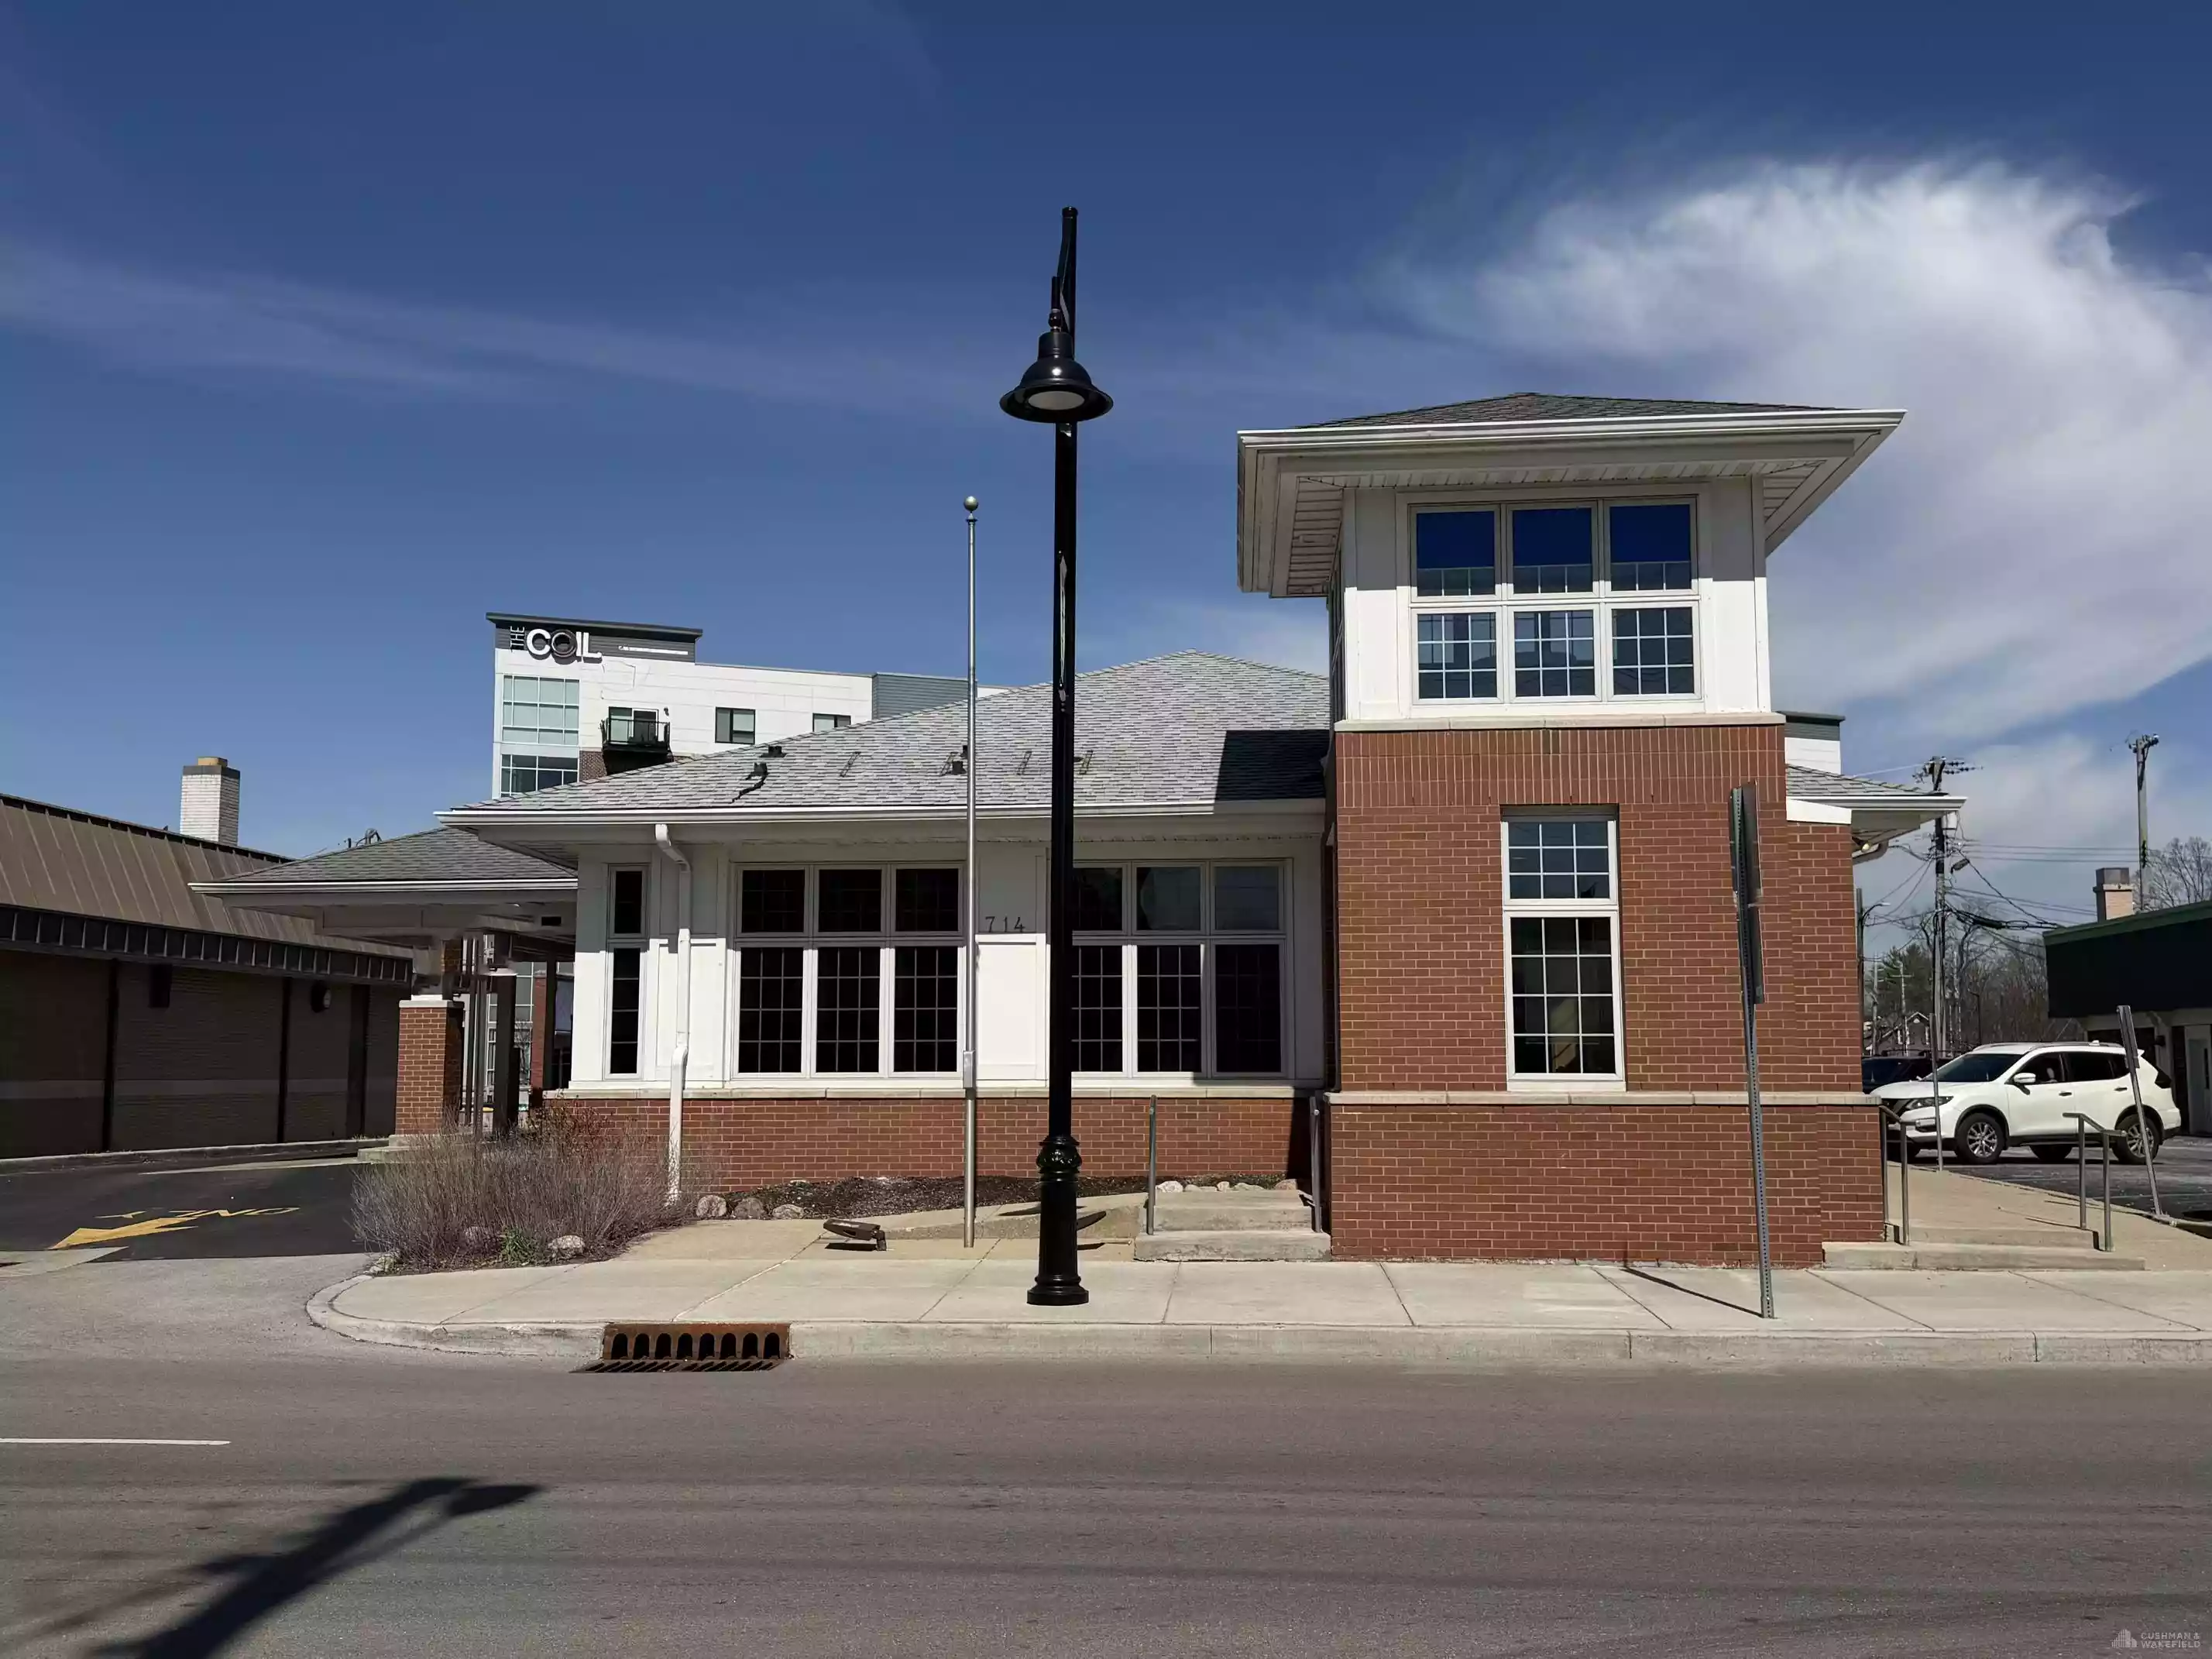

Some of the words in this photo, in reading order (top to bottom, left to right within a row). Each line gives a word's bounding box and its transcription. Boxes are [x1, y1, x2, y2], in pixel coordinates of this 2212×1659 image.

[510, 626, 525, 648] THE
[527, 629, 603, 658] COIL
[984, 915, 1026, 933] 714
